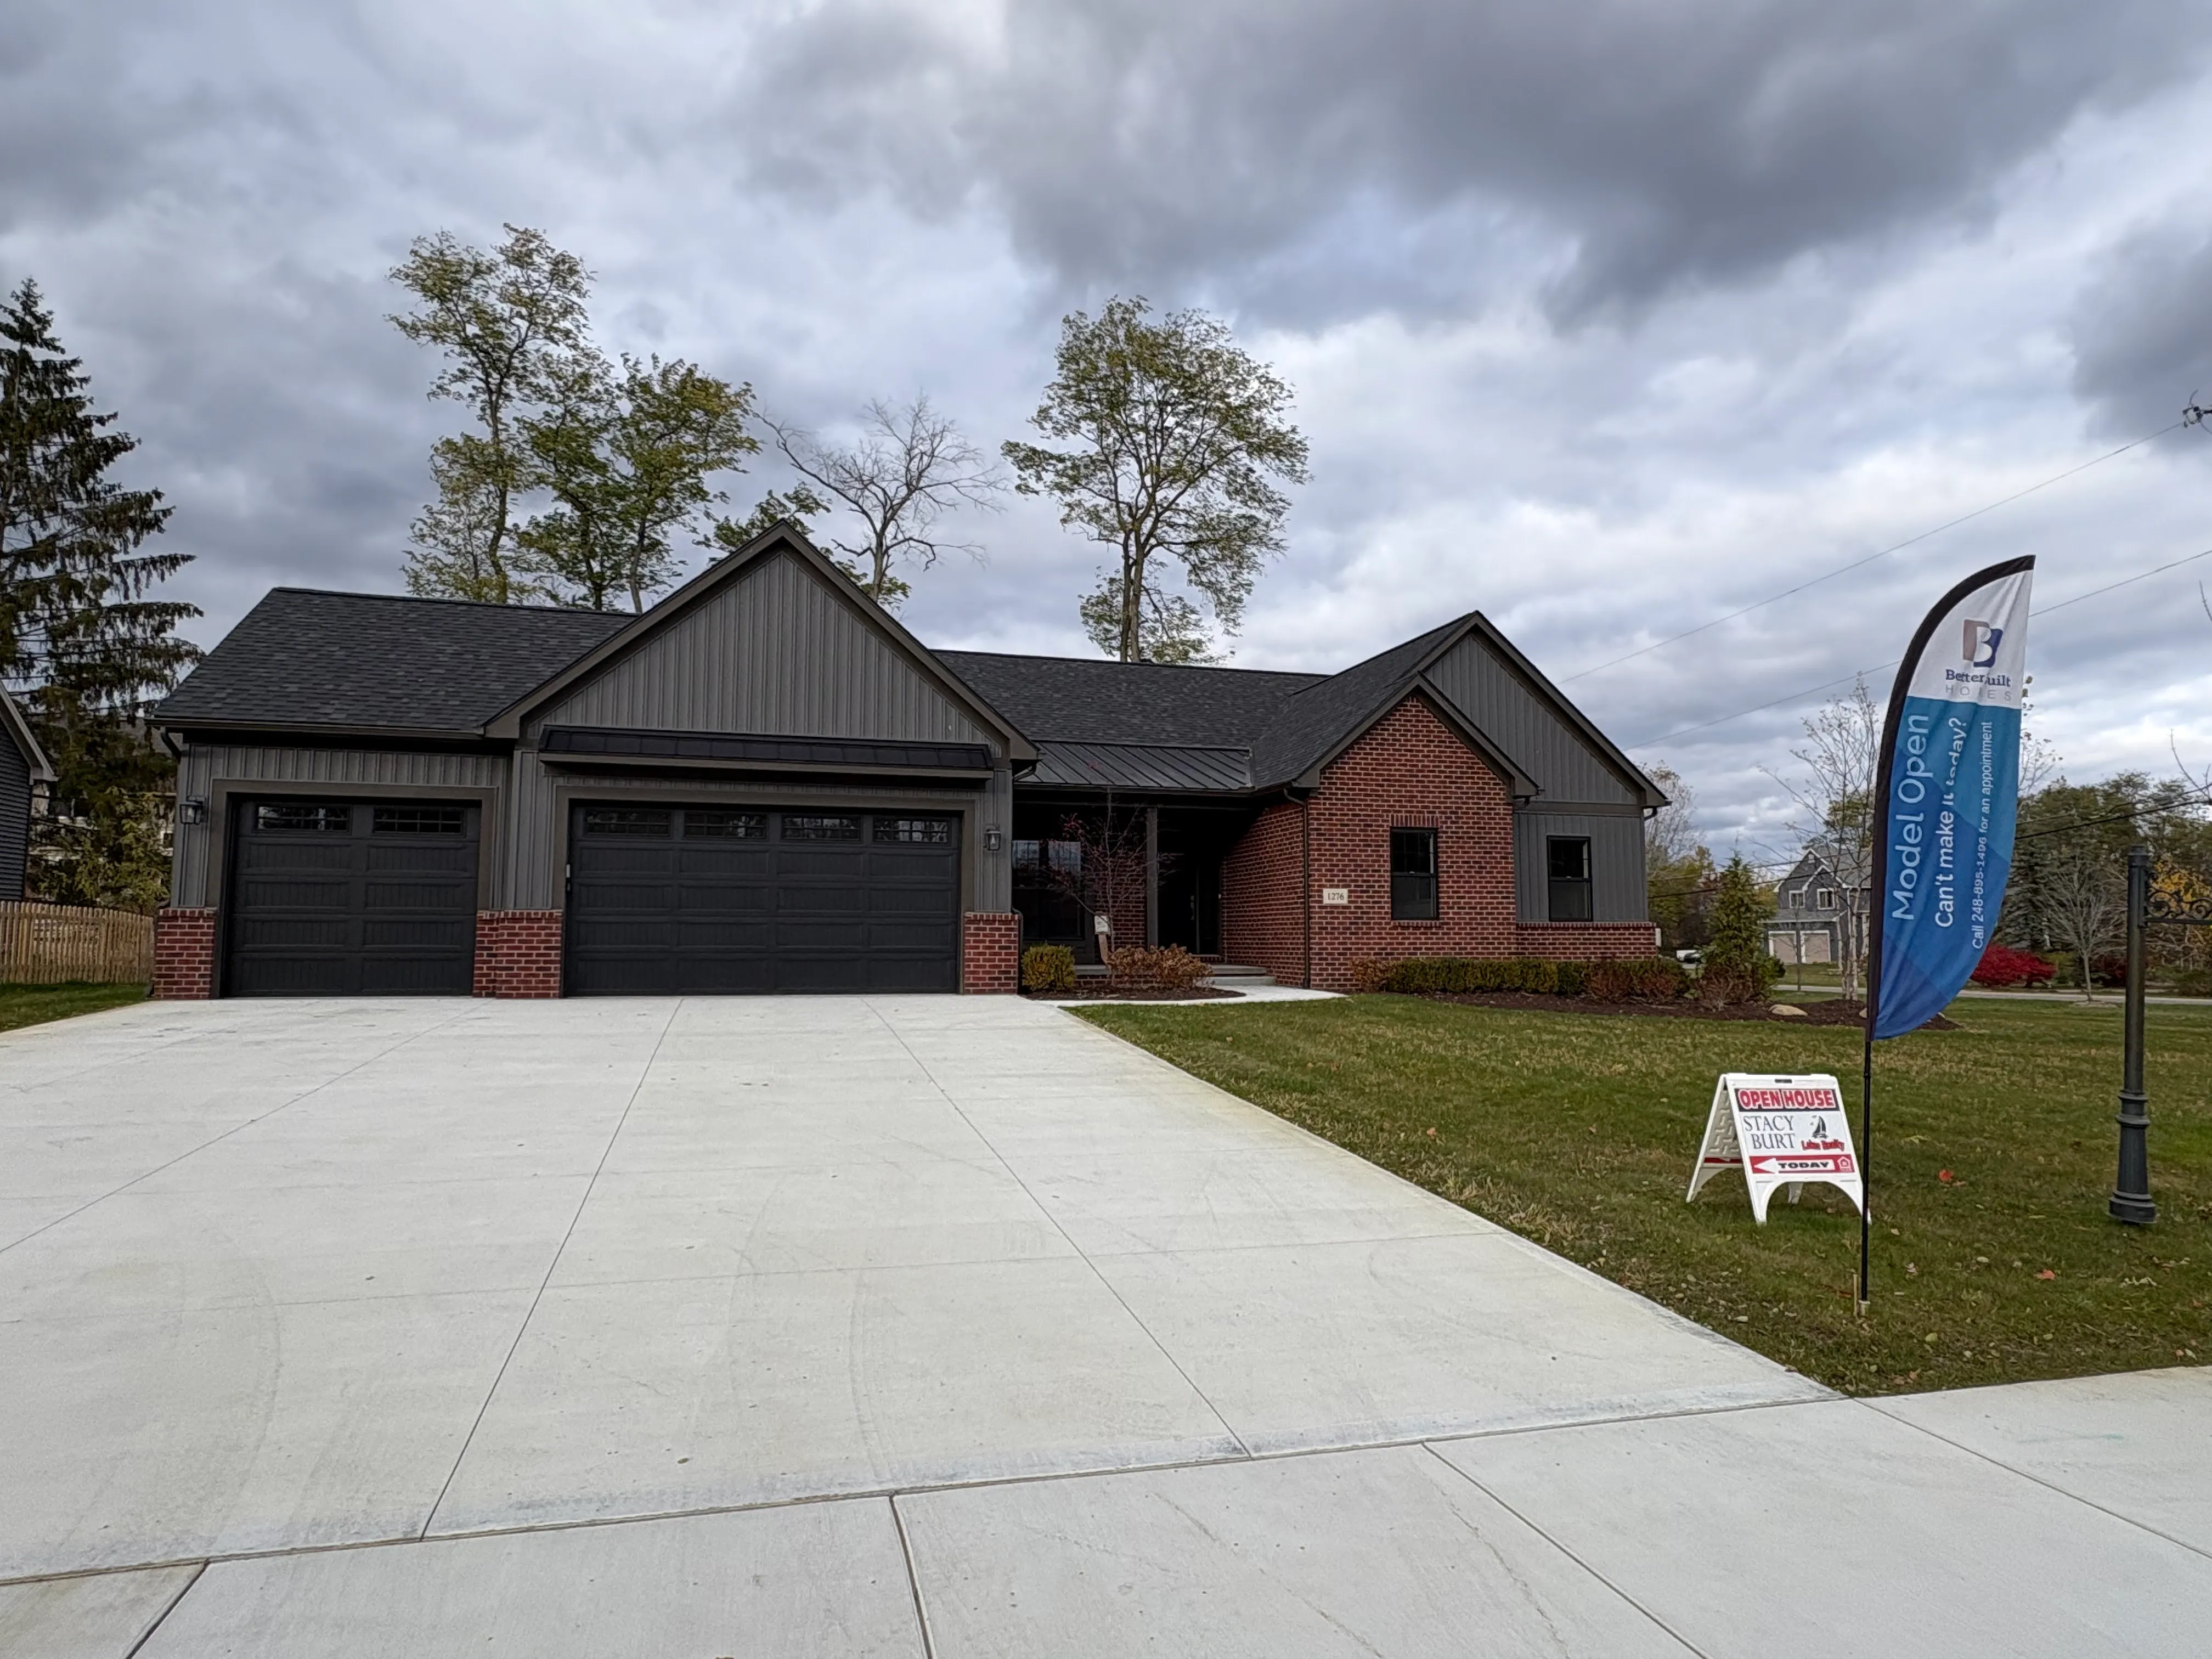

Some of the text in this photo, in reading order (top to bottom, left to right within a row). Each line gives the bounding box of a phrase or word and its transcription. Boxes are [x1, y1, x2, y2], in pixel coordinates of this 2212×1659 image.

[1945, 669, 2011, 687] Betteruilt
[1945, 685, 2011, 701] HOES
[1945, 718, 1967, 786] today?
[1980, 721, 1993, 795] appointment
[1982, 799, 1990, 814] an
[1892, 715, 1933, 920] Model Open
[1978, 816, 1988, 833] for
[1936, 811, 1954, 868] make
[1328, 892, 1344, 900] 1276
[1935, 873, 1954, 928] Can't
[1972, 925, 1984, 949] Call
[1739, 1090, 1835, 1108] OPEN HOUSE
[1743, 1116, 1794, 1131] STACY
[1751, 1133, 1795, 1149] BURT
